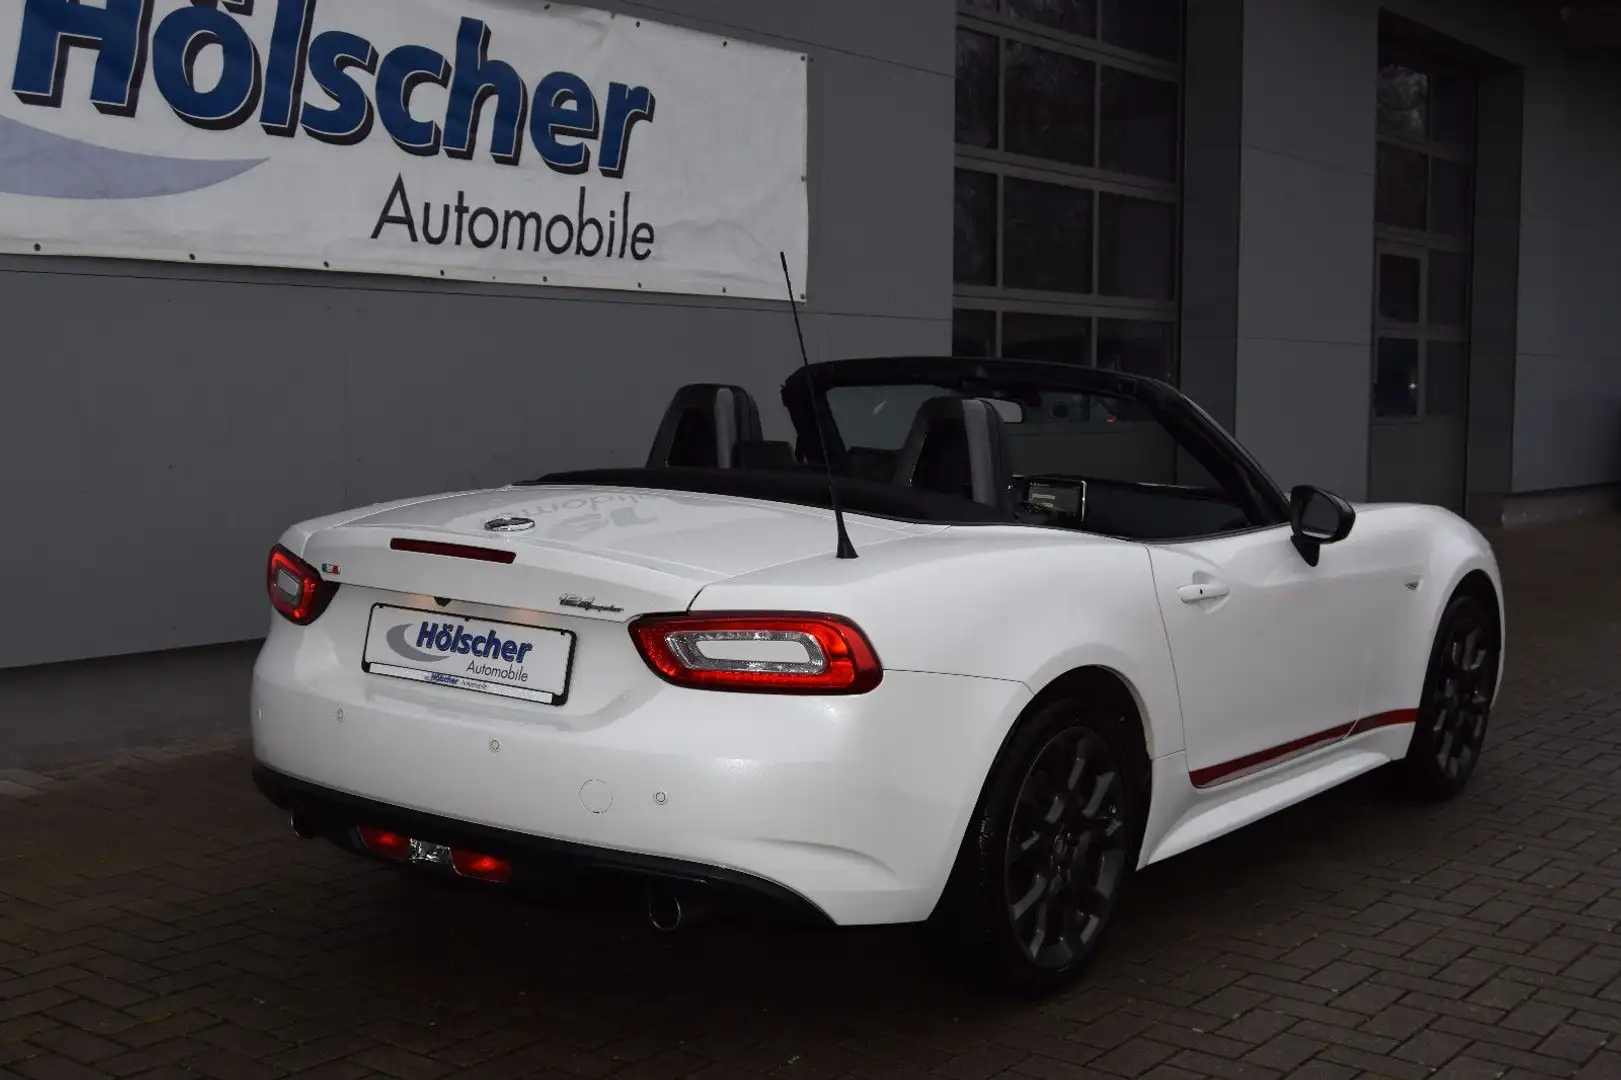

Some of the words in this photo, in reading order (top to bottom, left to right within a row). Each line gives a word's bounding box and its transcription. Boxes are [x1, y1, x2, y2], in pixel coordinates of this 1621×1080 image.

[11, 0, 655, 179] Hölscher
[370, 172, 656, 262] Automobile
[416, 620, 533, 664] Hölscher
[465, 660, 529, 683] Automobile
